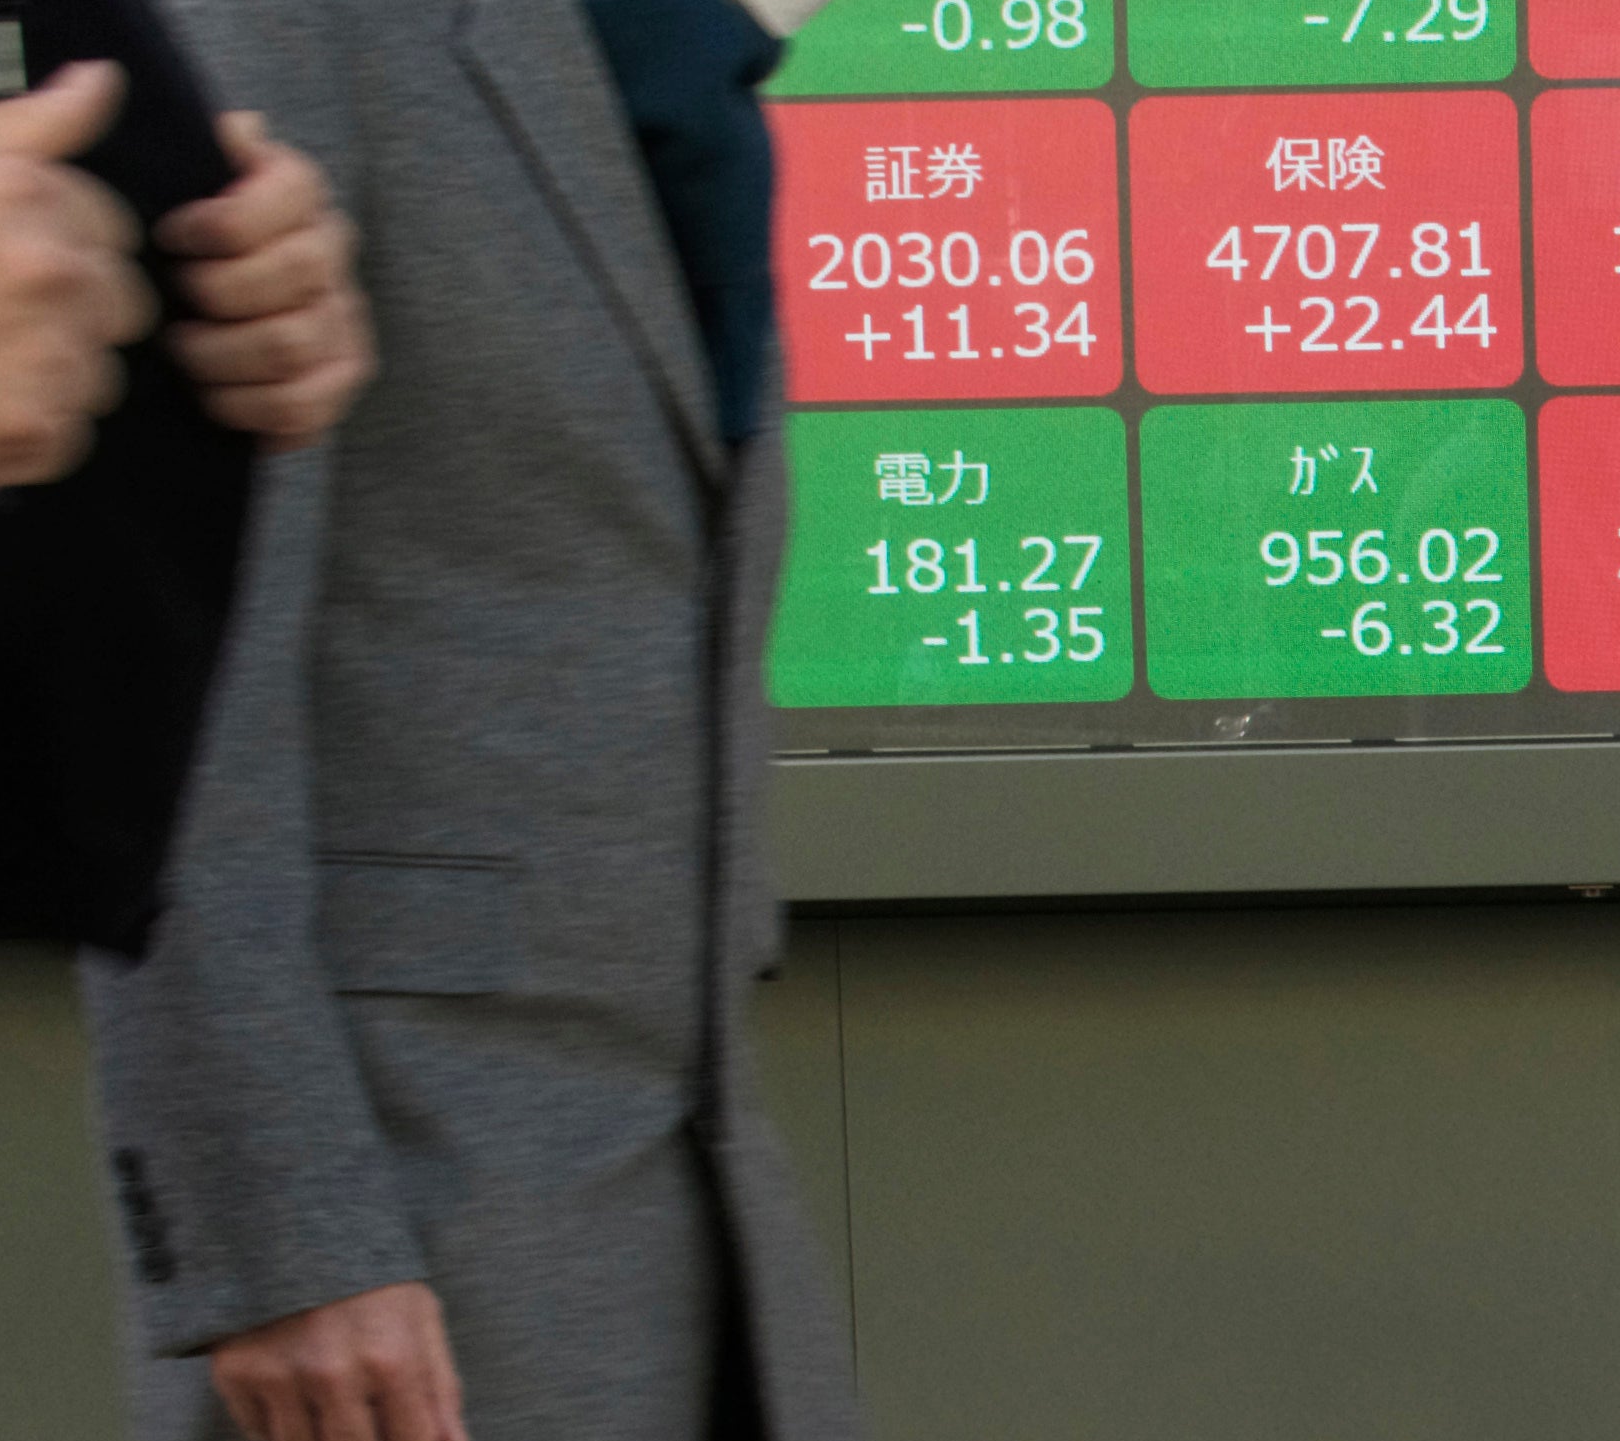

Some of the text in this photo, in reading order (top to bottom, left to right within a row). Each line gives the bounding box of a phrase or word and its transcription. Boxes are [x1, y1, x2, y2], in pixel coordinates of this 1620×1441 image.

[864, 143, 983, 202] 証券
[1265, 135, 1387, 193] 保険
[807, 229, 1095, 290] 2030.06
[1206, 220, 1492, 282] 4707.81
[845, 301, 1097, 361] +11.34
[1244, 292, 1497, 353] +22.44
[874, 449, 991, 507] 電力
[1287, 443, 1379, 496] ガス
[866, 534, 1103, 595] 181.27
[1258, 526, 1503, 588] 956.02
[922, 606, 1106, 665] -1.35
[1320, 598, 1506, 657] -6.32
